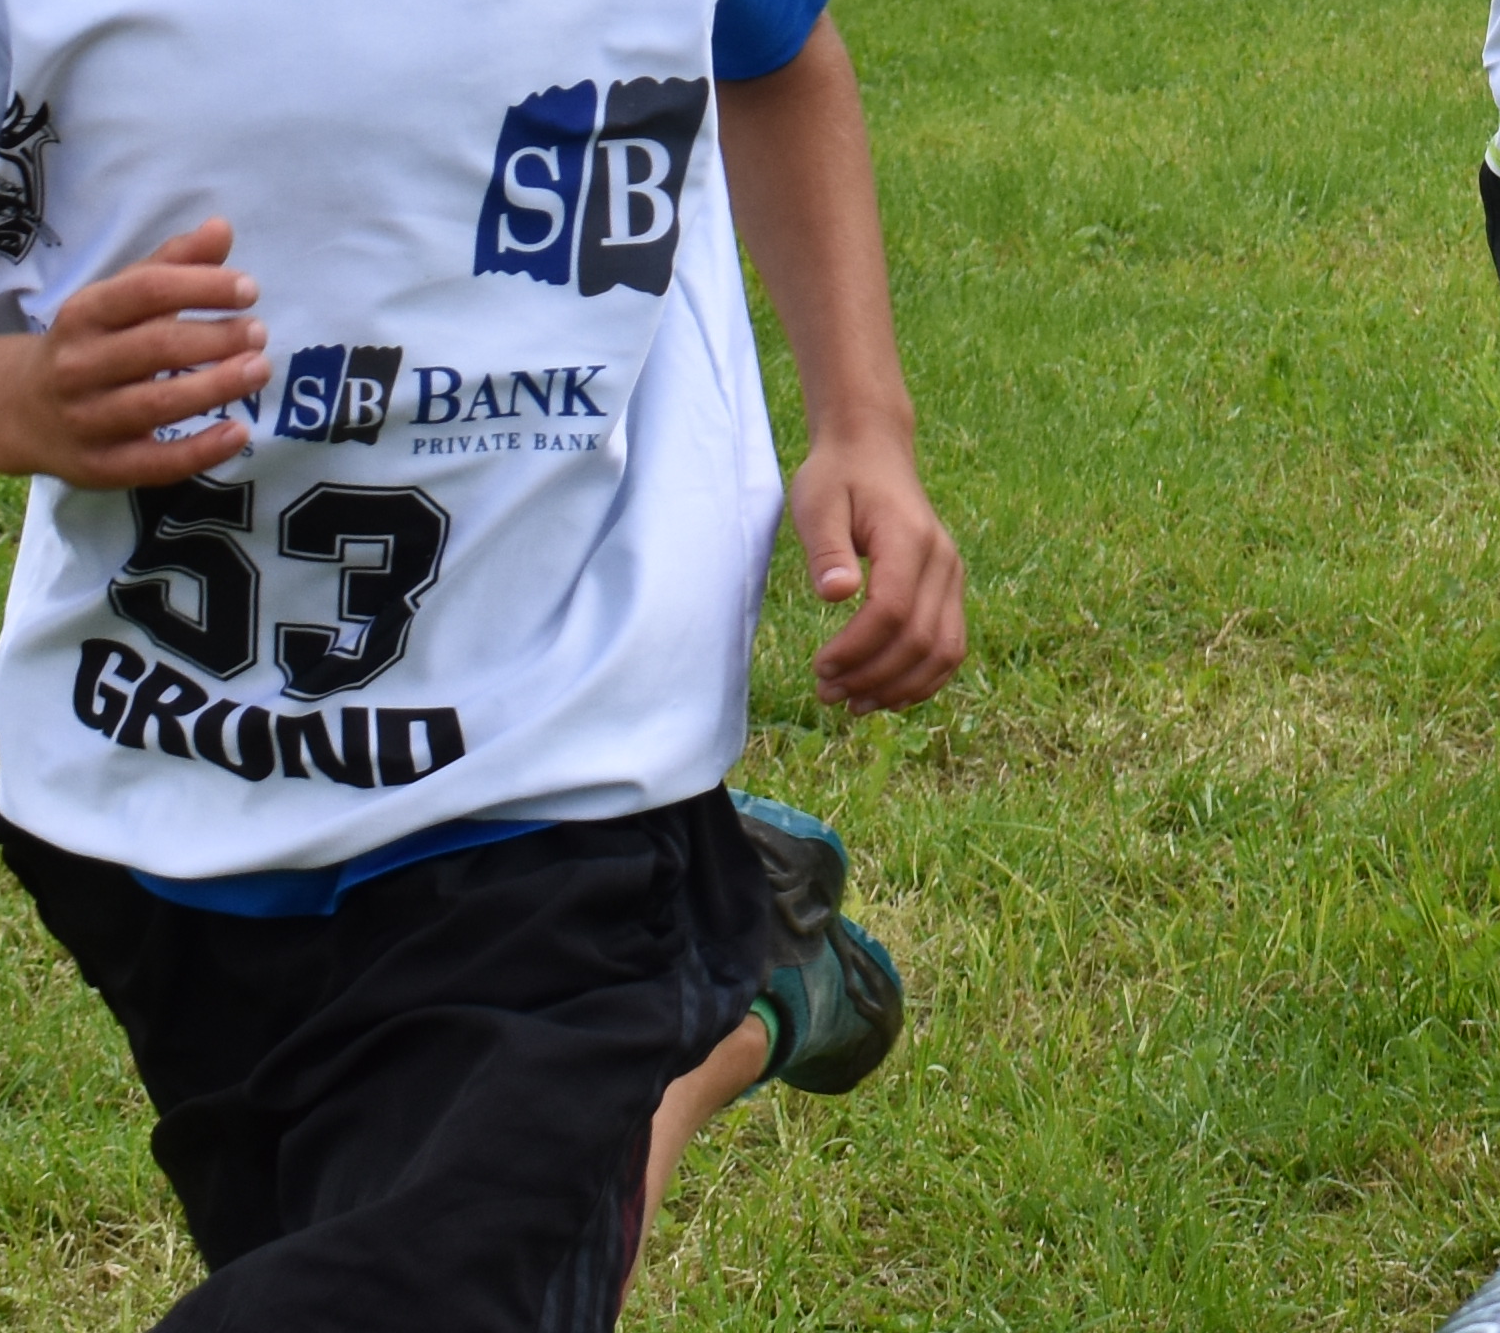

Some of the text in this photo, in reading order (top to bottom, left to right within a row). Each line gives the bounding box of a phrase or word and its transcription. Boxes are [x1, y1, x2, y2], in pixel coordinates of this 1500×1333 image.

[497, 136, 675, 254] SB
[286, 375, 385, 431] SB
[408, 364, 608, 425] BANK
[412, 432, 602, 456] PRIVATE BANK
[108, 474, 451, 702] 53
[72, 638, 467, 789] GRUND
